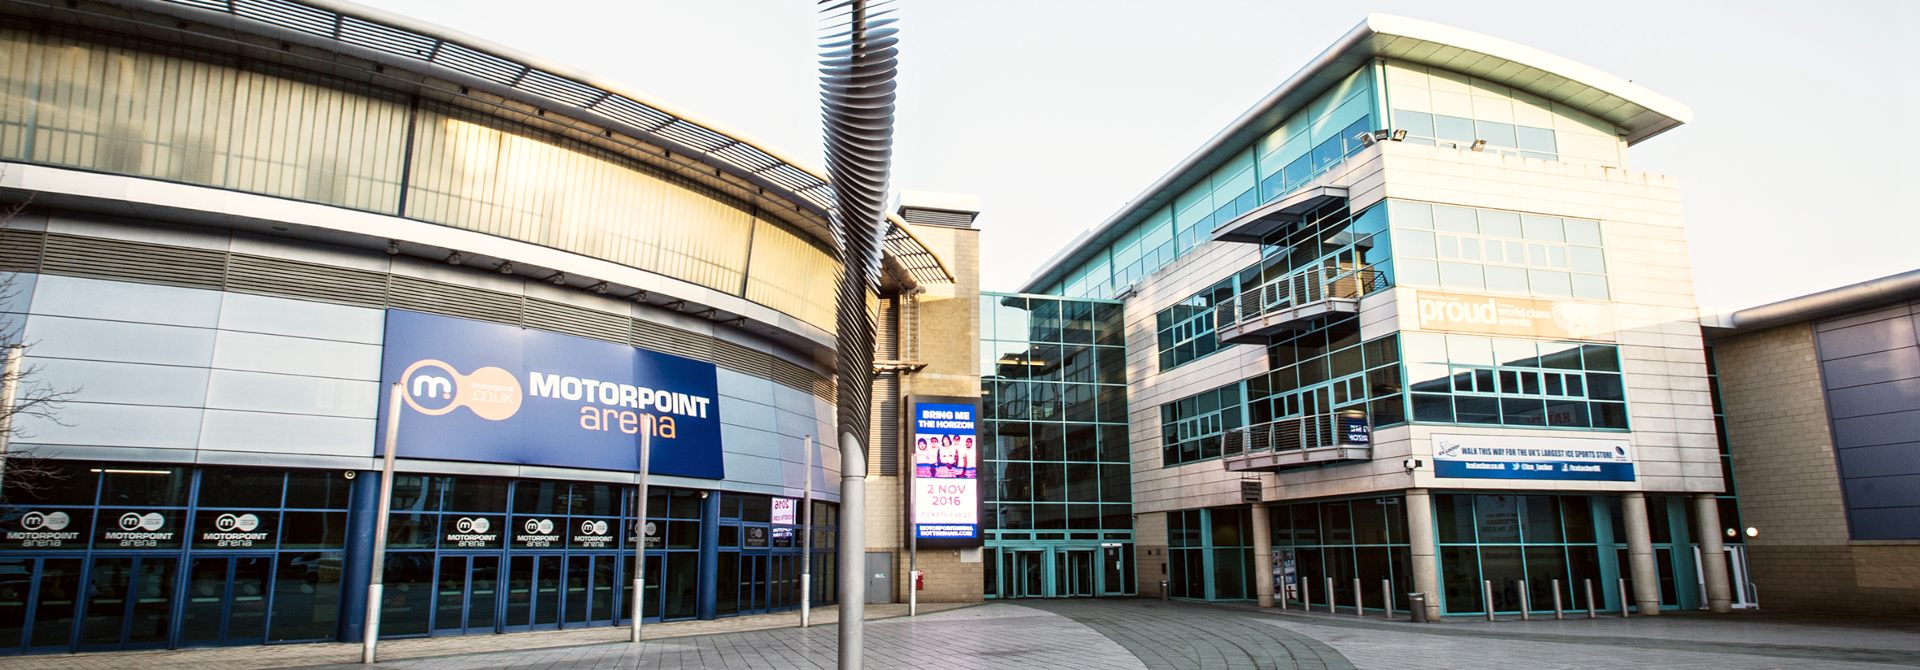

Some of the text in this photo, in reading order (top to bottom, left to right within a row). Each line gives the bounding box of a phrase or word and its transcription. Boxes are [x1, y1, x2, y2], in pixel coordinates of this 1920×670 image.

[1420, 299, 1496, 326] proud
[529, 371, 710, 419] MOTORPOINT
[922, 410, 970, 421] BRING ME
[580, 405, 676, 439] arena
[918, 419, 974, 429] THE HORIZON
[1461, 447, 1478, 455] WALK
[1479, 447, 1492, 455] THIS
[1492, 448, 1504, 456] WAY
[1505, 448, 1516, 456] FOR
[1517, 448, 1527, 456] THE
[1528, 449, 1540, 457] UK'S
[1541, 449, 1564, 457] LARGEST
[1565, 450, 1574, 458] ICE
[1574, 450, 1595, 458] SPORTS
[1596, 451, 1613, 459] STORE
[927, 484, 966, 494] 2 NOV
[931, 496, 961, 506] 2016
[6, 532, 79, 540] MOTORPOINT
[105, 532, 174, 540] MOTORPOINT
[22, 539, 61, 547] arena
[120, 539, 157, 547] arena
[217, 539, 252, 547] arena
